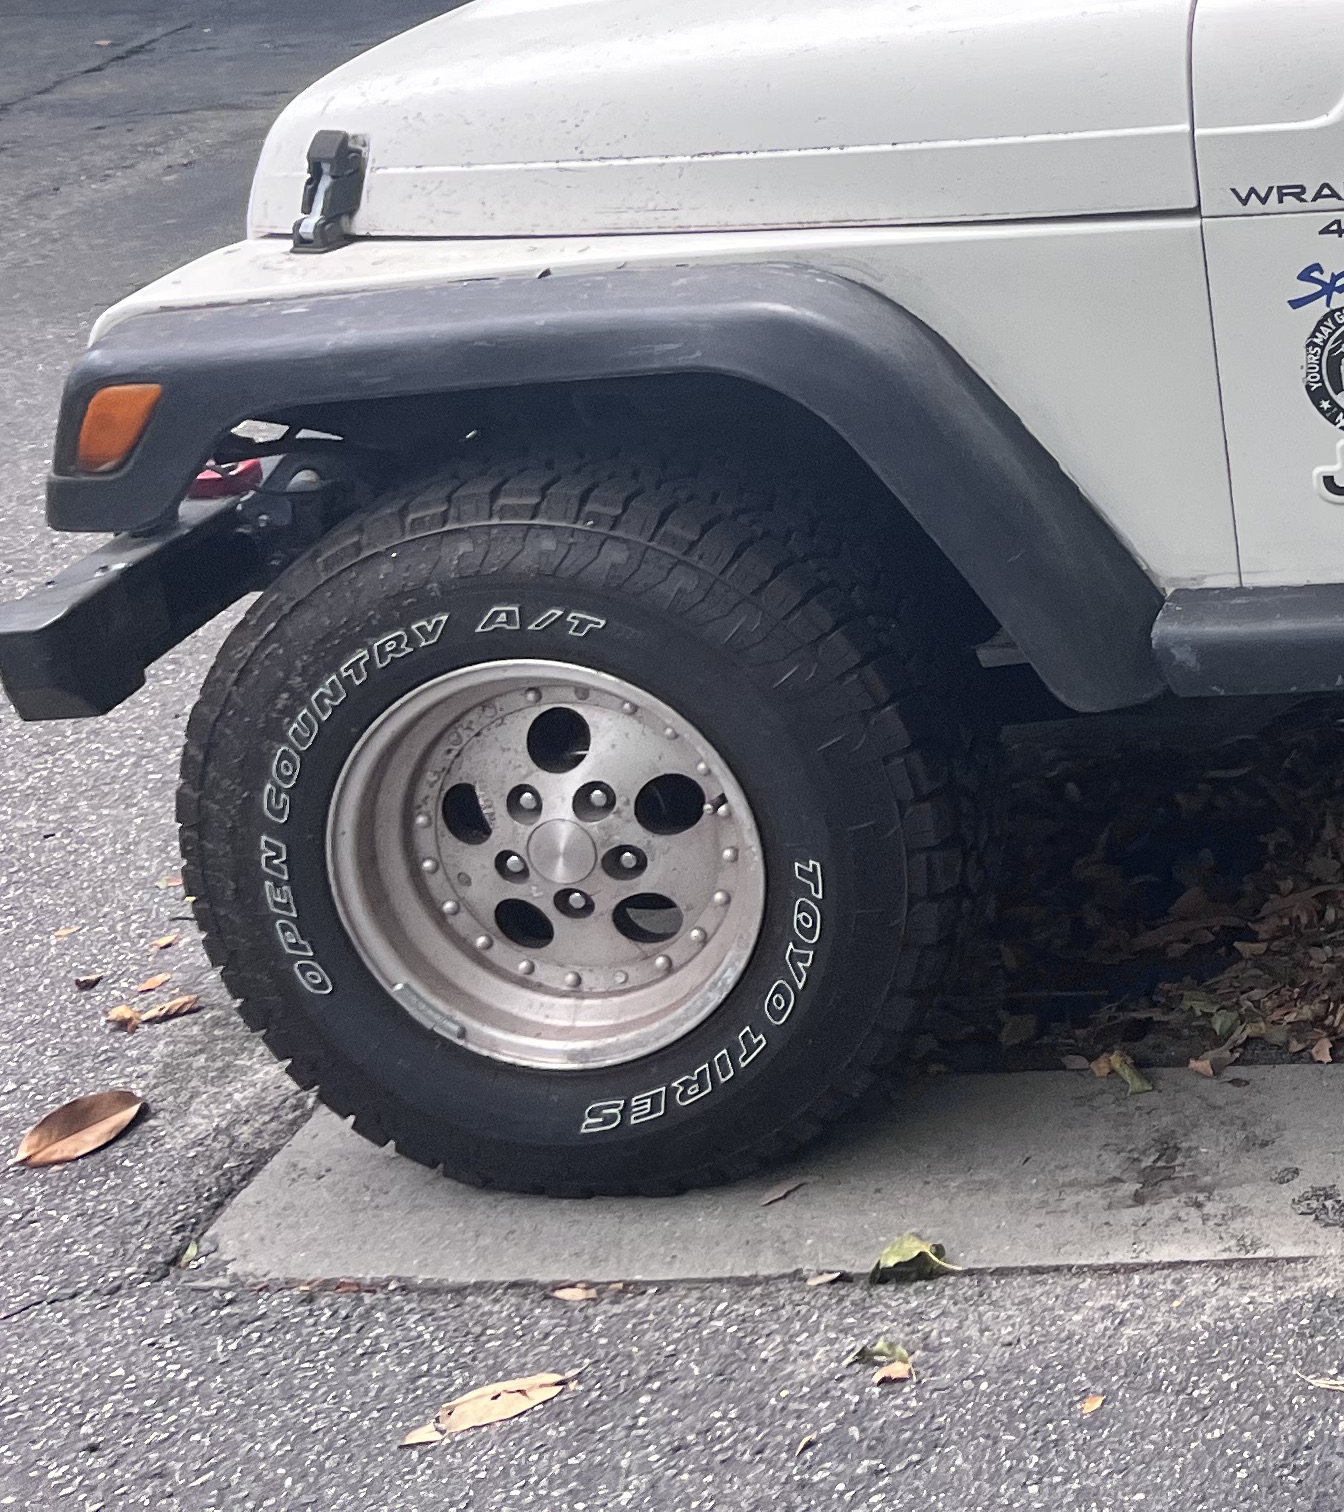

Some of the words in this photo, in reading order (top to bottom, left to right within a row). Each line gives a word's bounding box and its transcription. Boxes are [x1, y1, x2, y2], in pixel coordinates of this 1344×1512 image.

[1306, 346, 1322, 391] YOURS
[1314, 318, 1337, 346] MAY
[475, 604, 606, 637] A/T
[263, 613, 449, 823] COUNTRY
[258, 835, 334, 995] OPEN
[764, 859, 823, 1026] TOYO
[580, 1026, 767, 1133] TIRES
